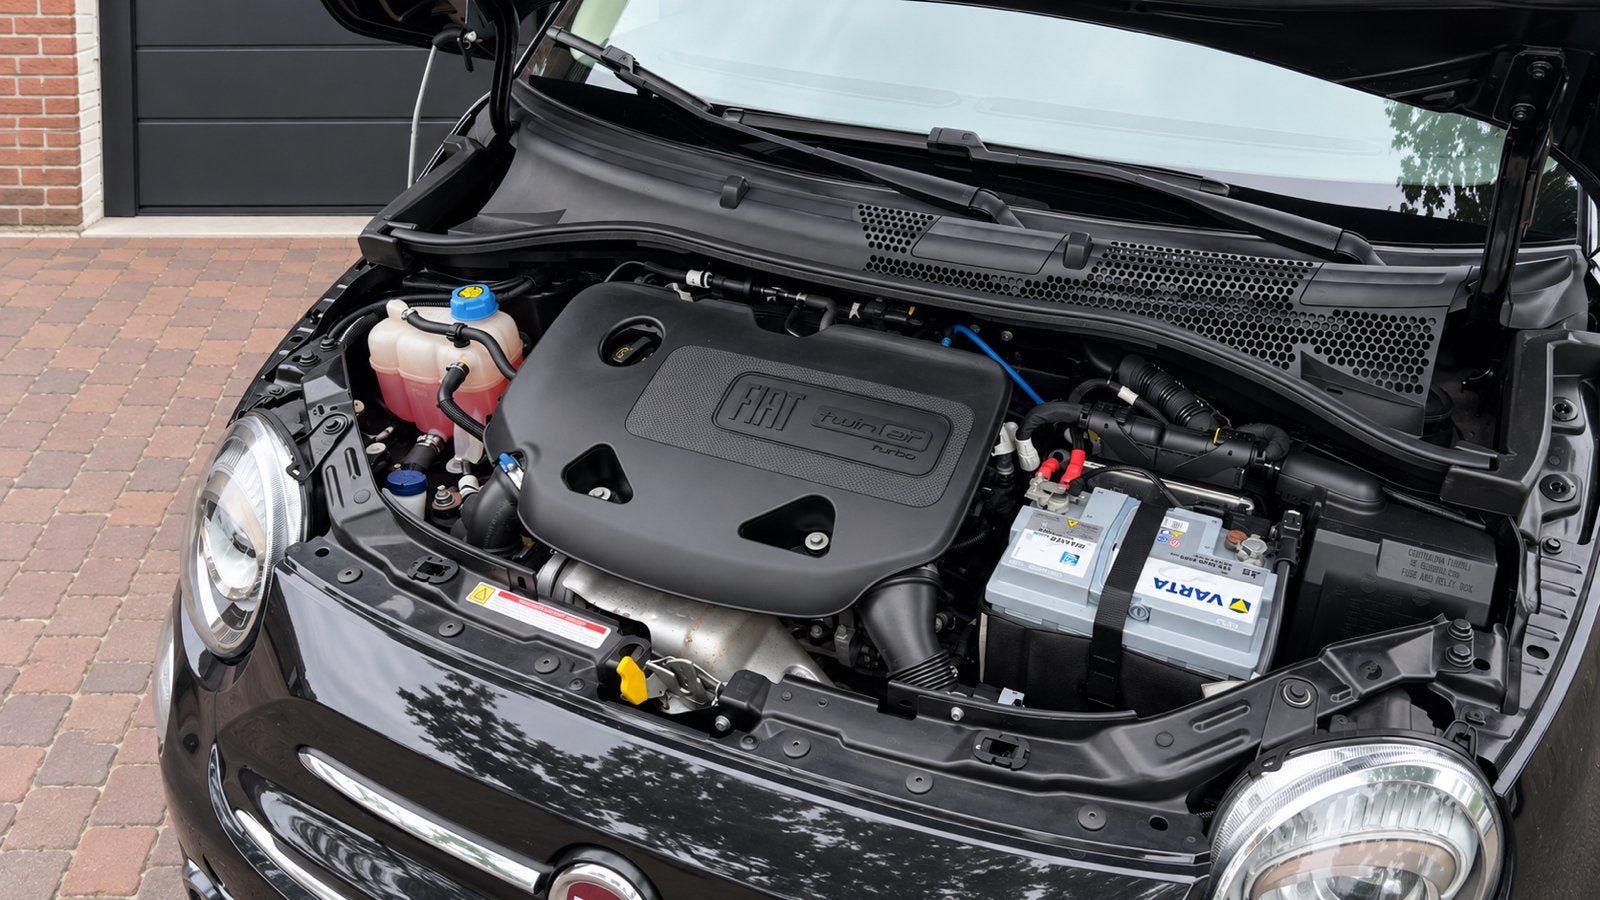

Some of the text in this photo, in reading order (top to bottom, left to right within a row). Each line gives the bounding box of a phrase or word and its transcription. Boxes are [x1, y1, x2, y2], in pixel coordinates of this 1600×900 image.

[729, 384, 806, 431] FIAT
[872, 444, 916, 461] turbo
[1154, 577, 1223, 606] VARTA
[1419, 572, 1434, 583] AND
[1460, 582, 1474, 593] BOX
